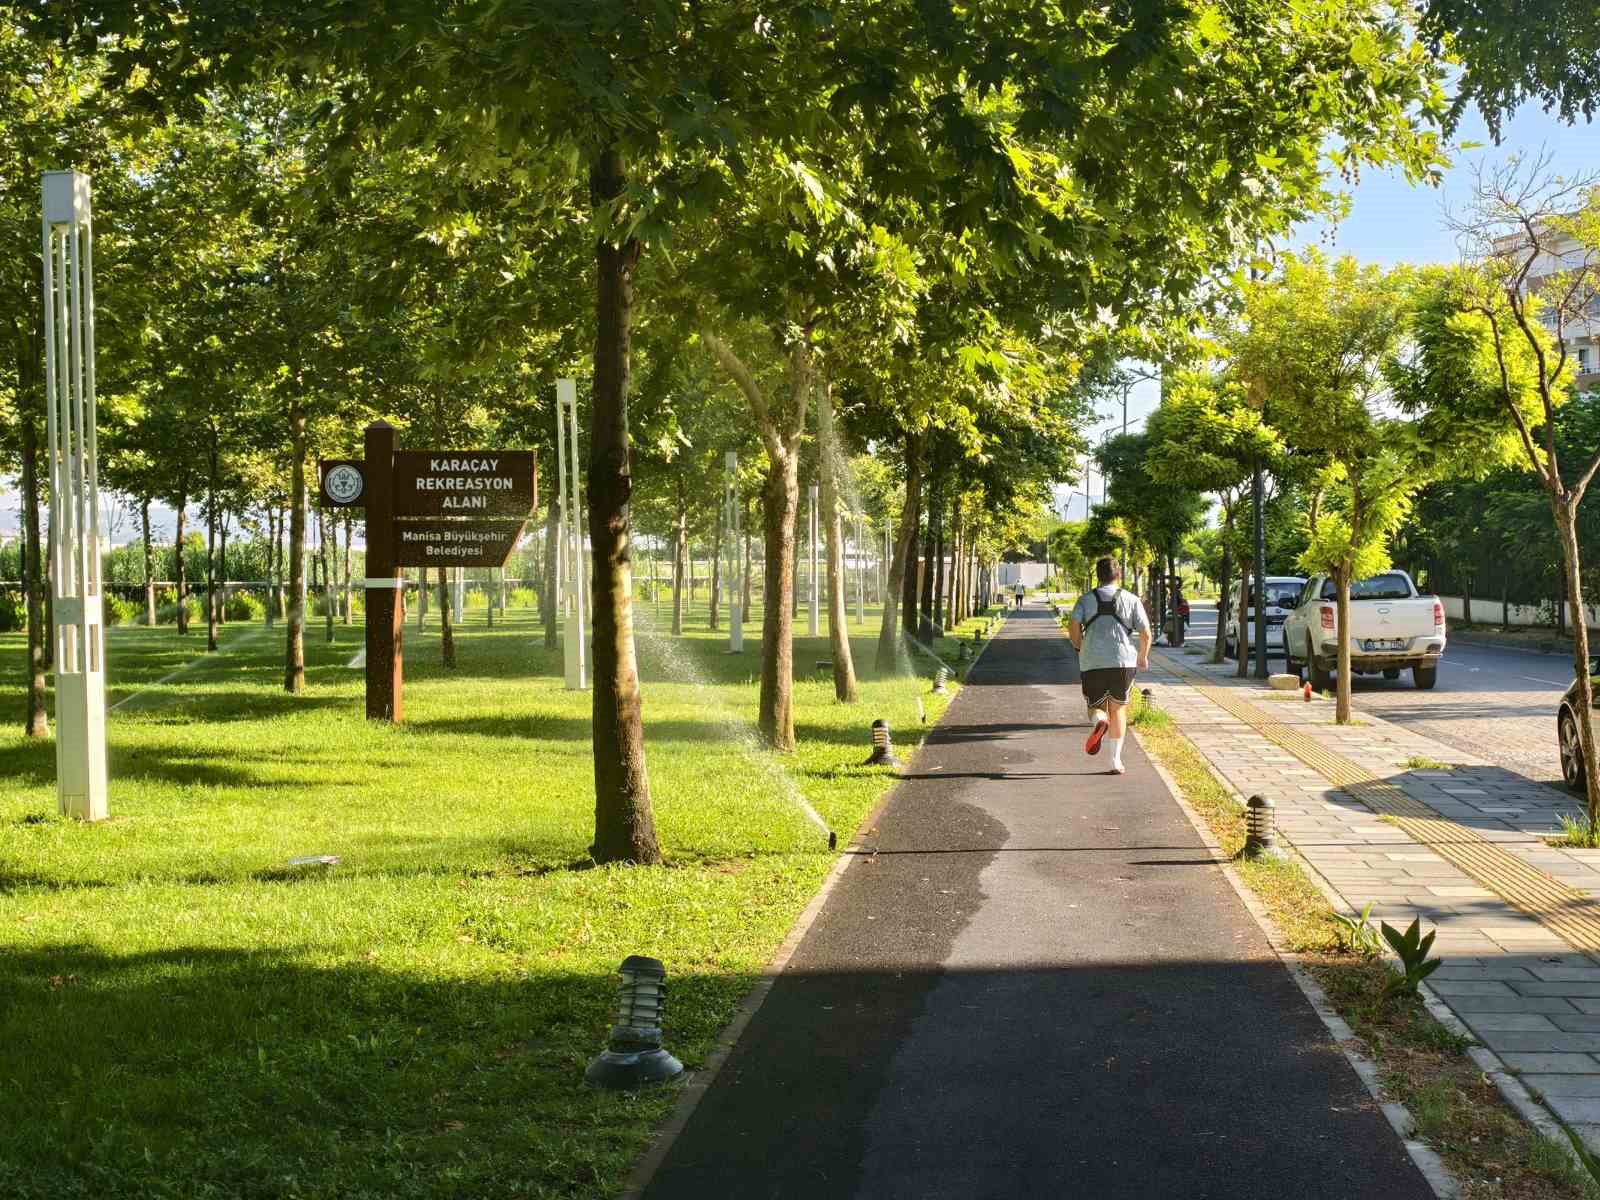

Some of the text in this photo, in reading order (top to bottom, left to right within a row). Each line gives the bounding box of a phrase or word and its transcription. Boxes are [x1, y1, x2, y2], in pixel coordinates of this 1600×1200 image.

[430, 459, 498, 473] KARAÇAY
[416, 478, 513, 490] REKREASYON
[442, 496, 487, 508] ALANI
[402, 530, 506, 543] Manisa Büyükşehir
[425, 545, 483, 557] Belediyesi
